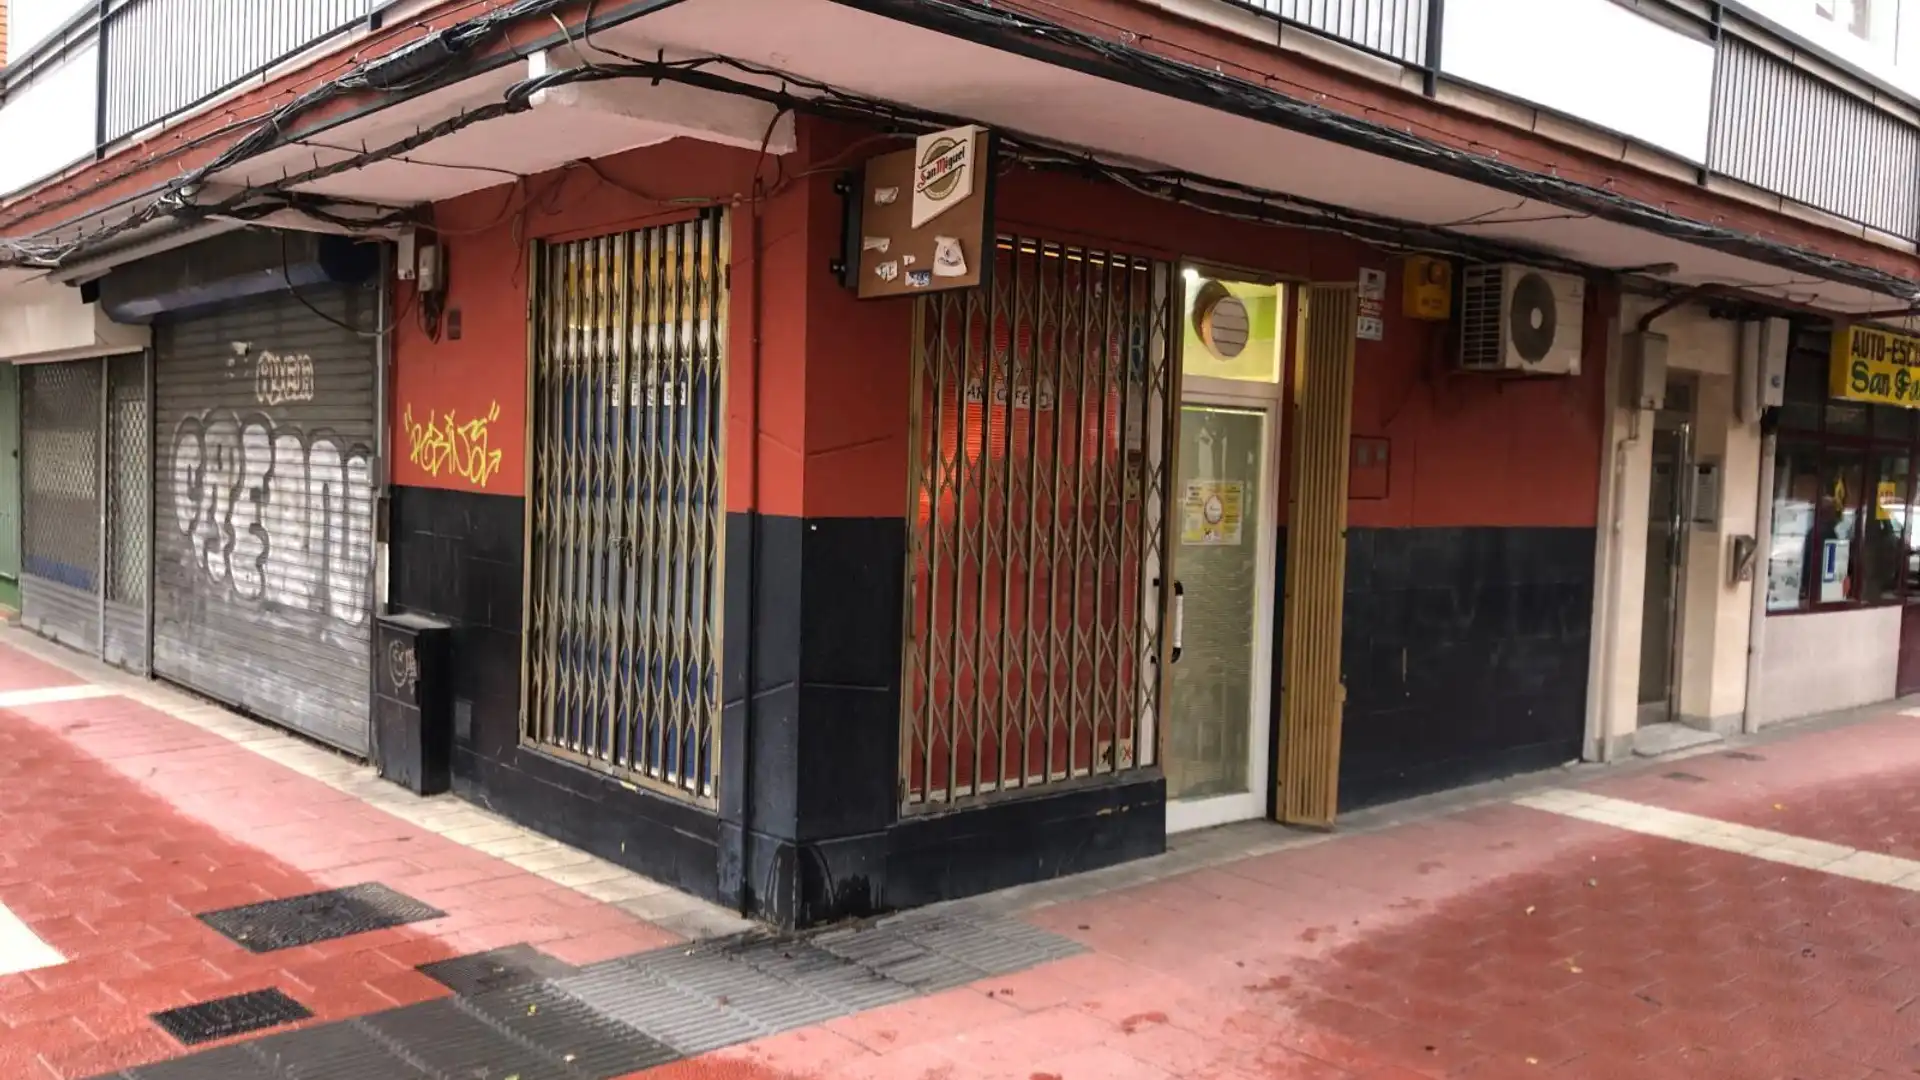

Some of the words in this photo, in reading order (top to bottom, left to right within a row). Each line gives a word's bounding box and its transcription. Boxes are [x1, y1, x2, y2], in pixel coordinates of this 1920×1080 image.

[917, 168, 936, 189] San
[936, 146, 965, 174] Miguel
[1851, 360, 1889, 397] San
